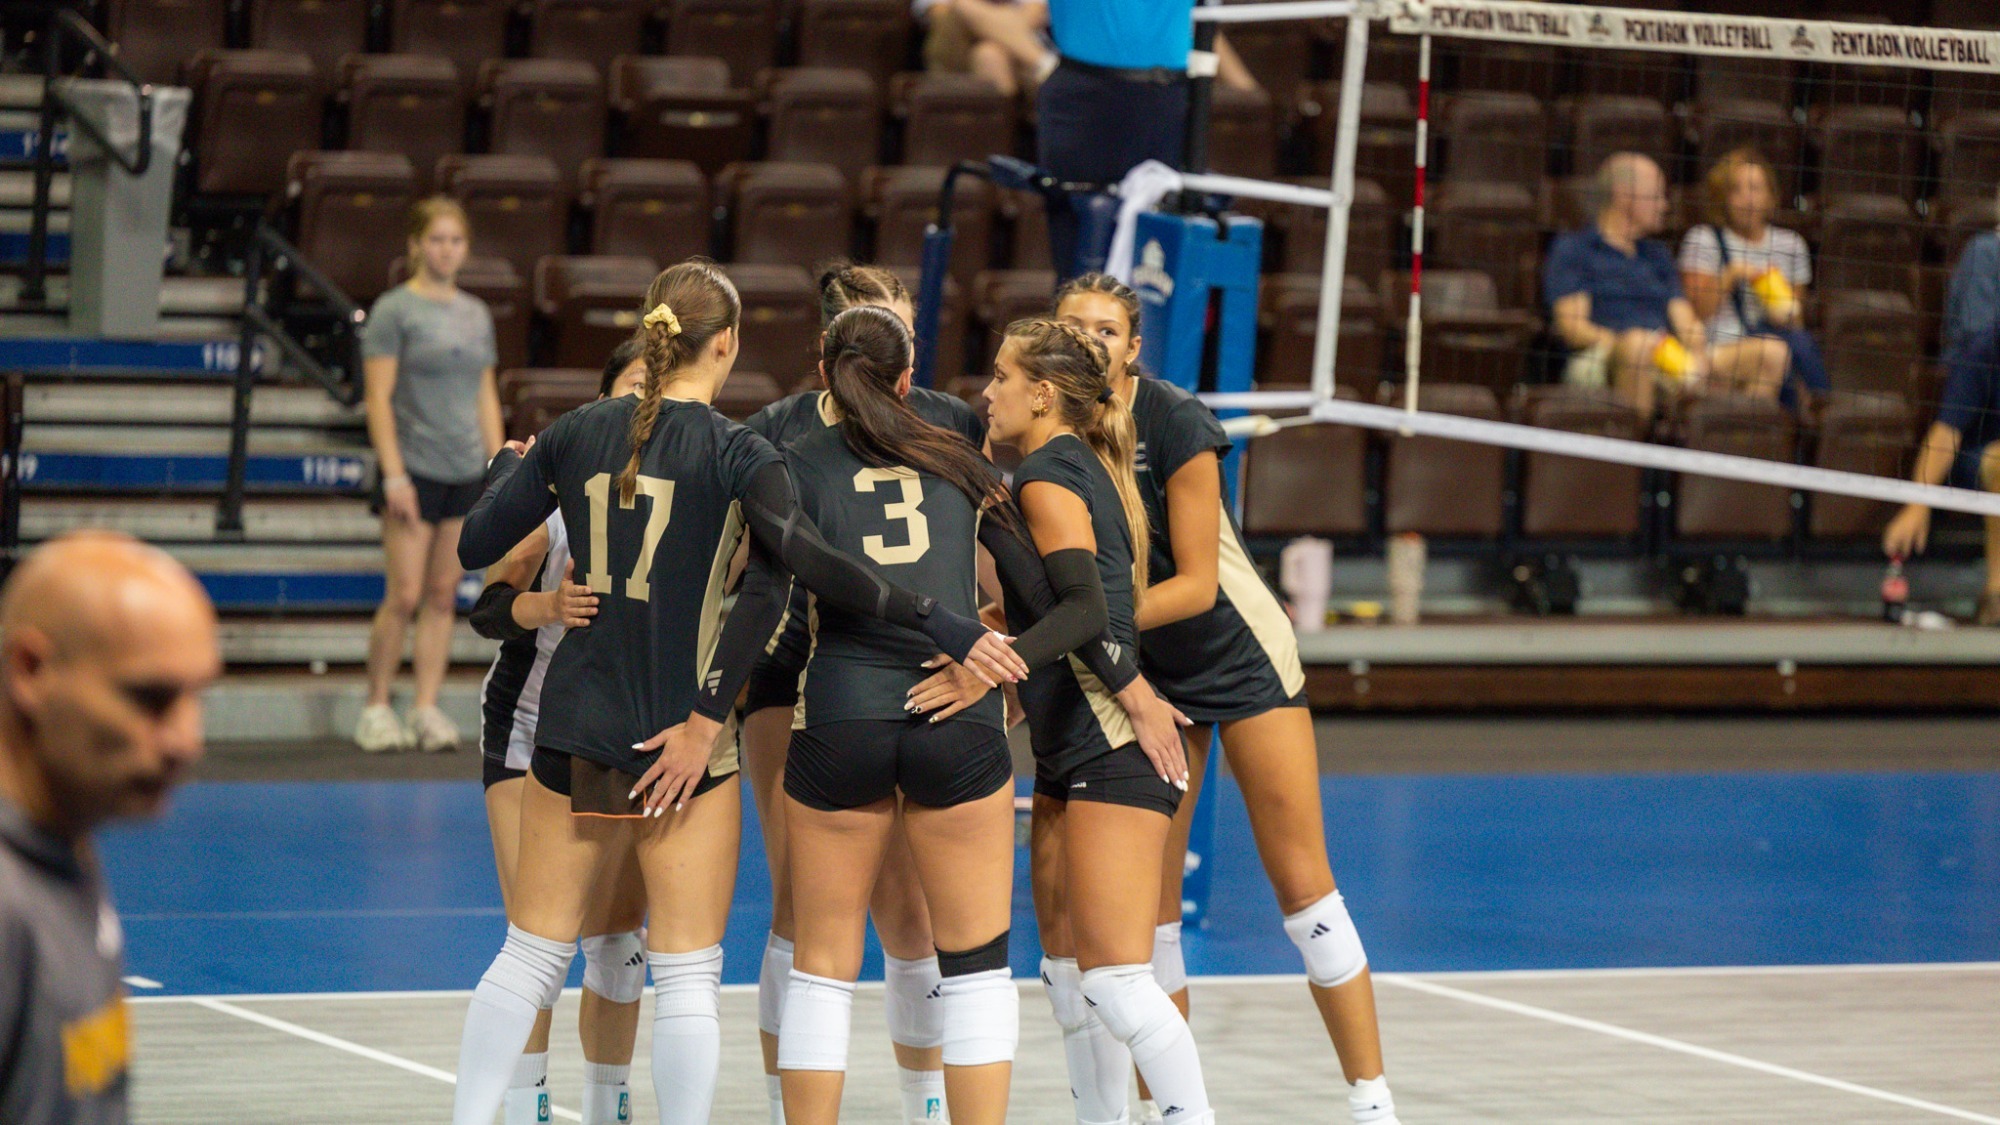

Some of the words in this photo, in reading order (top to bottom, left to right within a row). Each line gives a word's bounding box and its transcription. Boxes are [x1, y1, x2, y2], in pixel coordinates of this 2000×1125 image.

[1624, 19, 1689, 44] PENTAGON
[1693, 23, 1773, 50] VOLLEYBALL
[1832, 31, 1903, 59] PENTAGON
[1904, 35, 1991, 65] VOLLEYBALL
[585, 472, 676, 602] 17
[852, 465, 931, 566] 3
